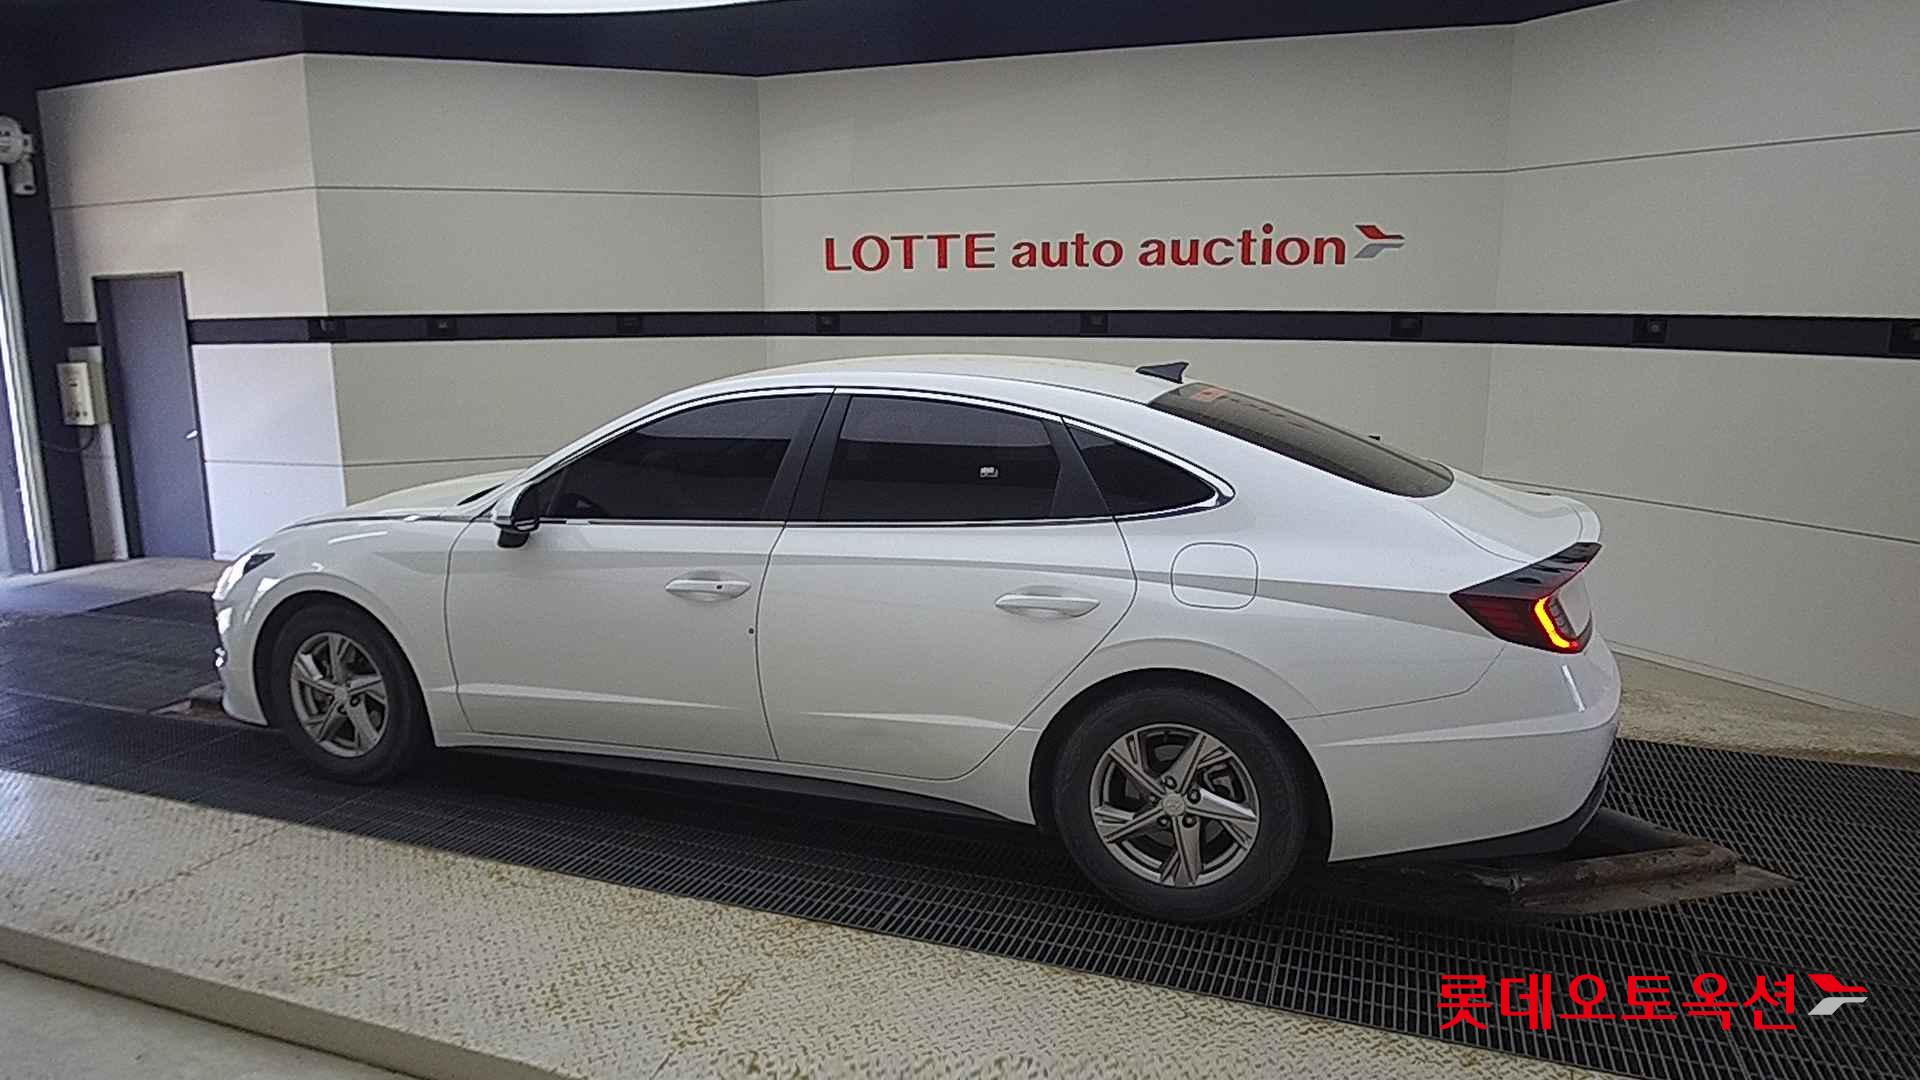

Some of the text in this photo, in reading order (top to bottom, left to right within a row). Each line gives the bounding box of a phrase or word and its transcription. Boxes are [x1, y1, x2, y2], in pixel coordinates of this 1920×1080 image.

[824, 223, 1346, 272] LOTTE auto auction
